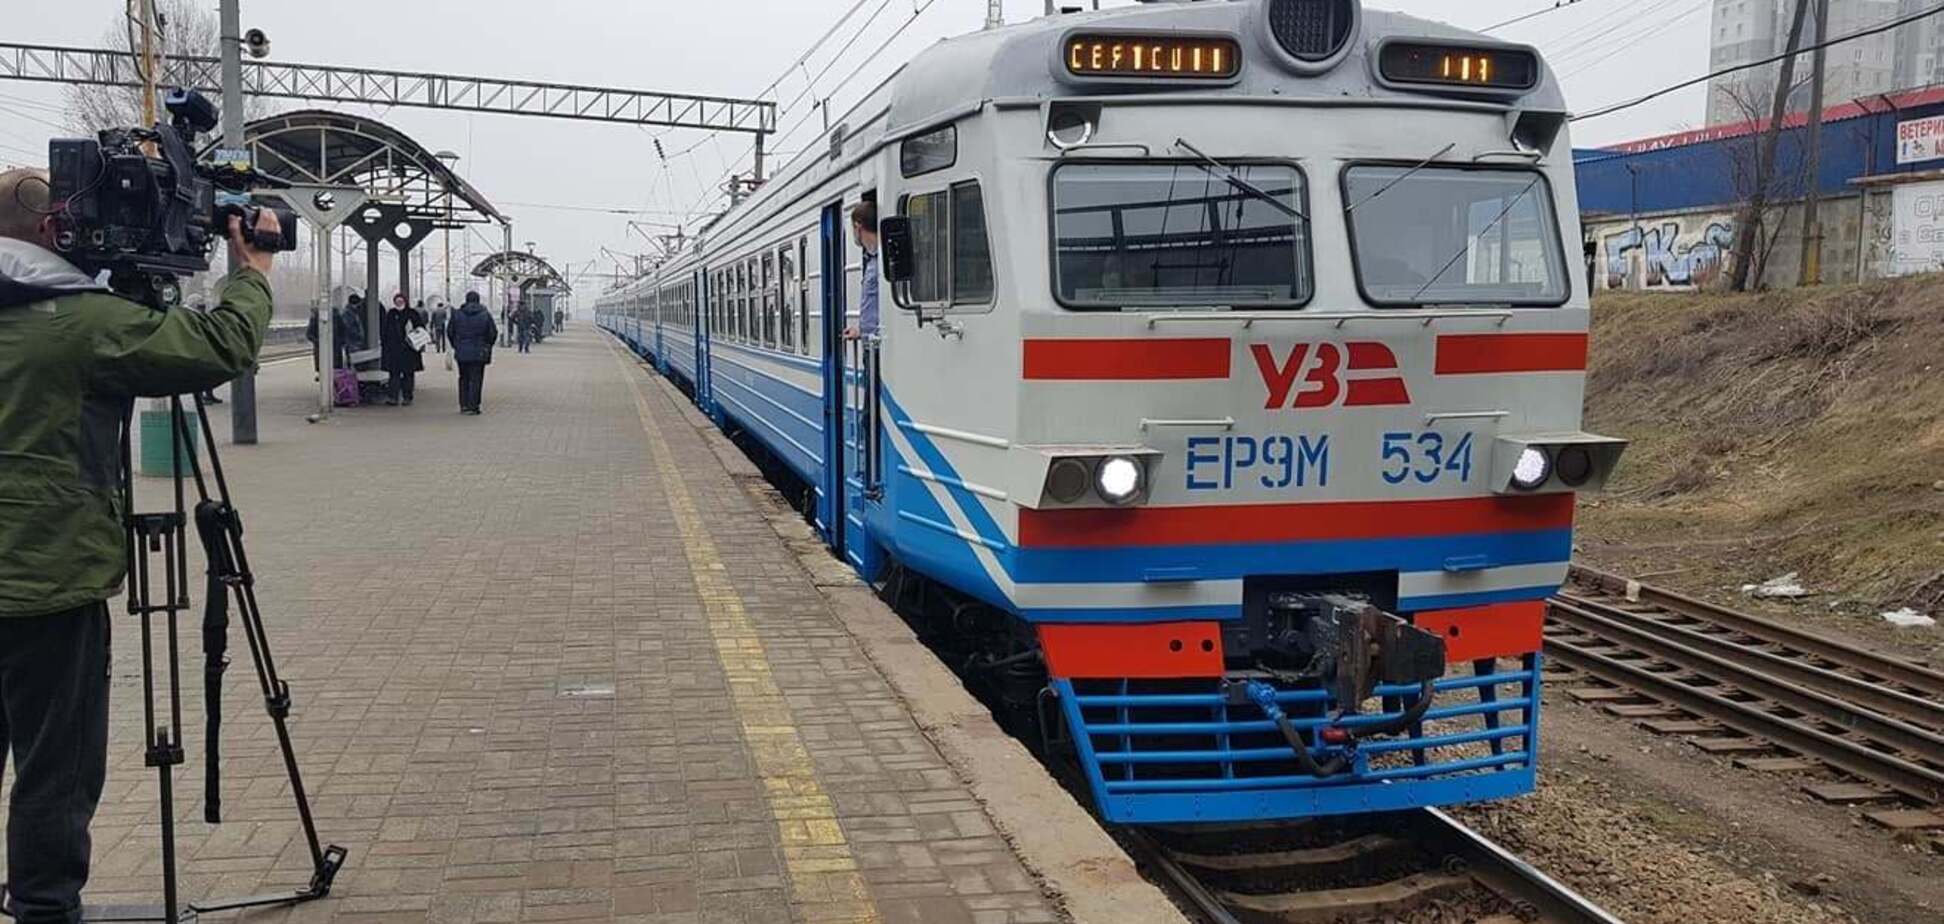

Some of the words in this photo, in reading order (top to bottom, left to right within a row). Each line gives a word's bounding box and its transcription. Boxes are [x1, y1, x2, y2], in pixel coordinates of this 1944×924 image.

[1900, 119, 1944, 140] ВЕТЕРИ
[1186, 434, 1329, 490] ЕР9М
[1382, 431, 1473, 485] 534
